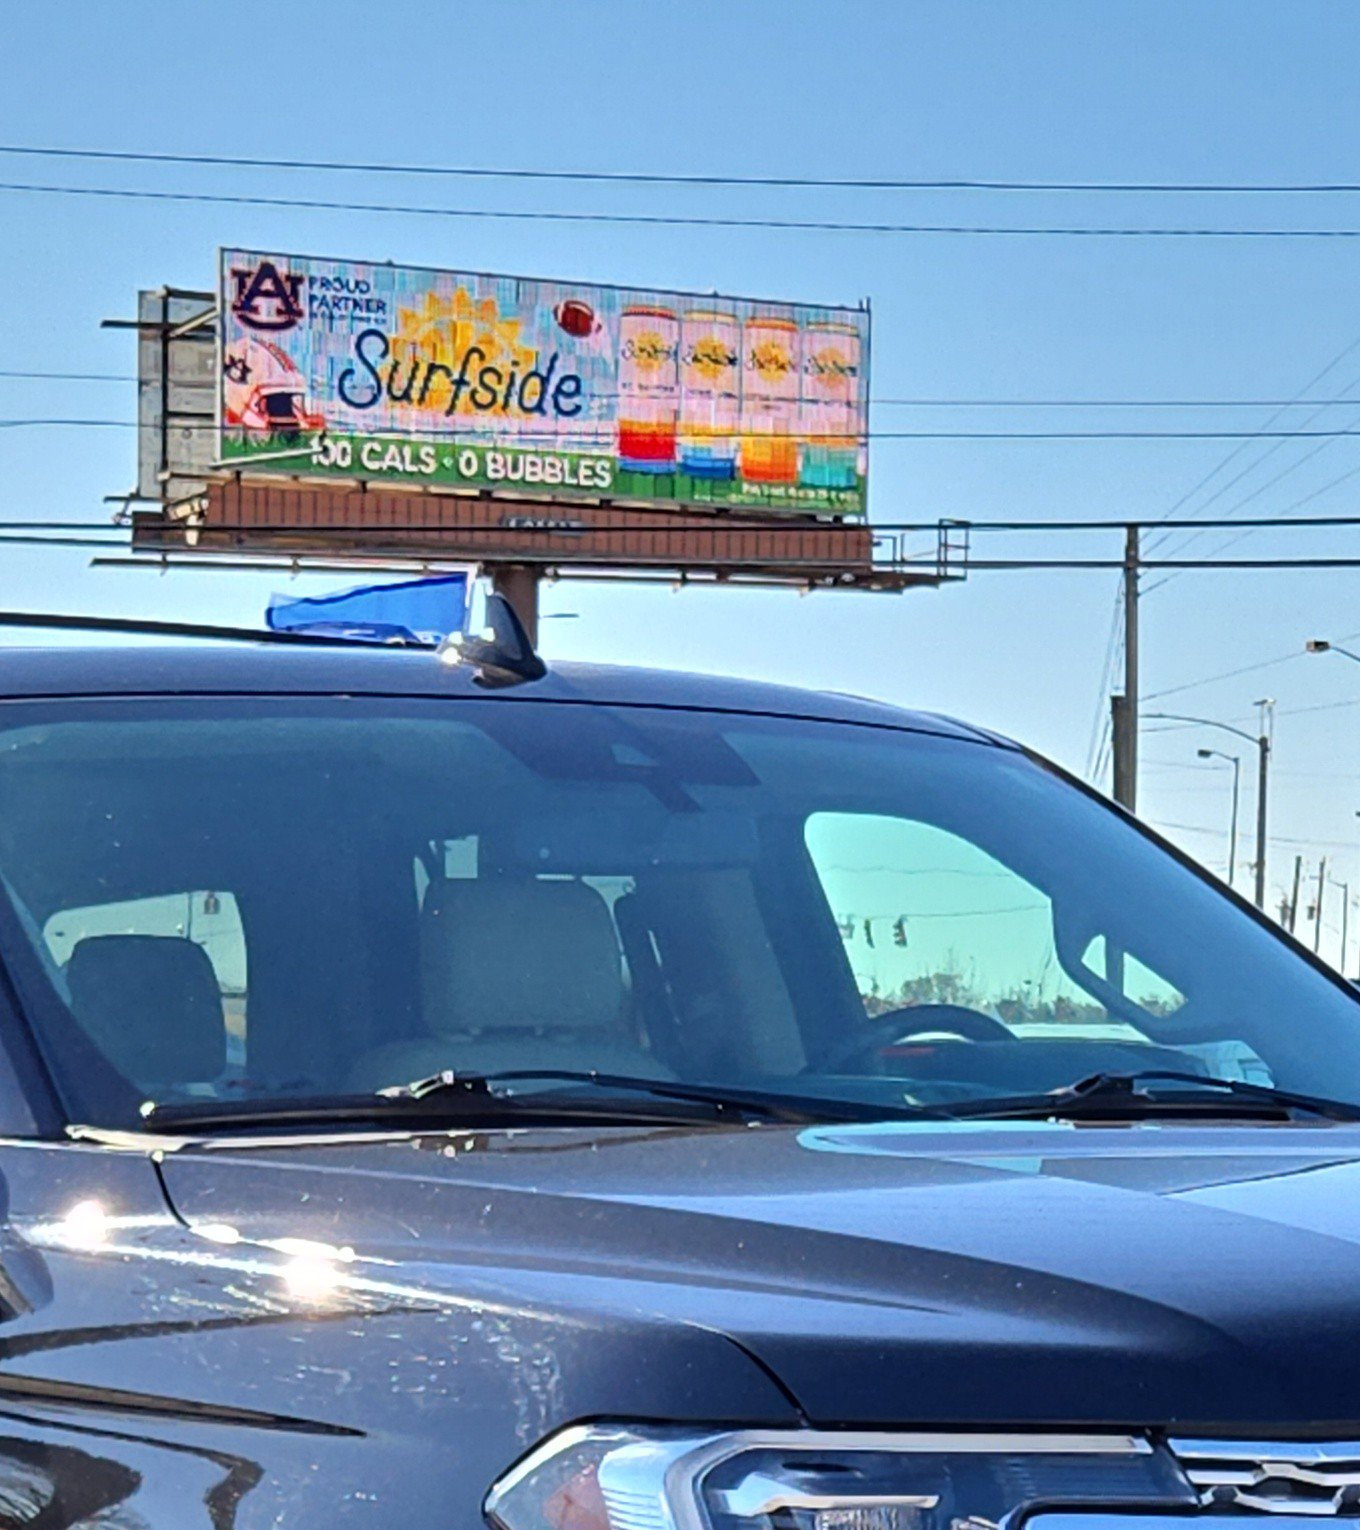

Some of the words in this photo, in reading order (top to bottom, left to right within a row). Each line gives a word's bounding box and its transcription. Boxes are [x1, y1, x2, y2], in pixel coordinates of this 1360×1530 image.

[308, 276, 371, 294] PROUD
[308, 293, 387, 315] PARTNER
[339, 328, 584, 416] Surfside
[361, 441, 436, 475] CALS
[458, 453, 478, 477] 0
[486, 454, 613, 489] BUBBLES
